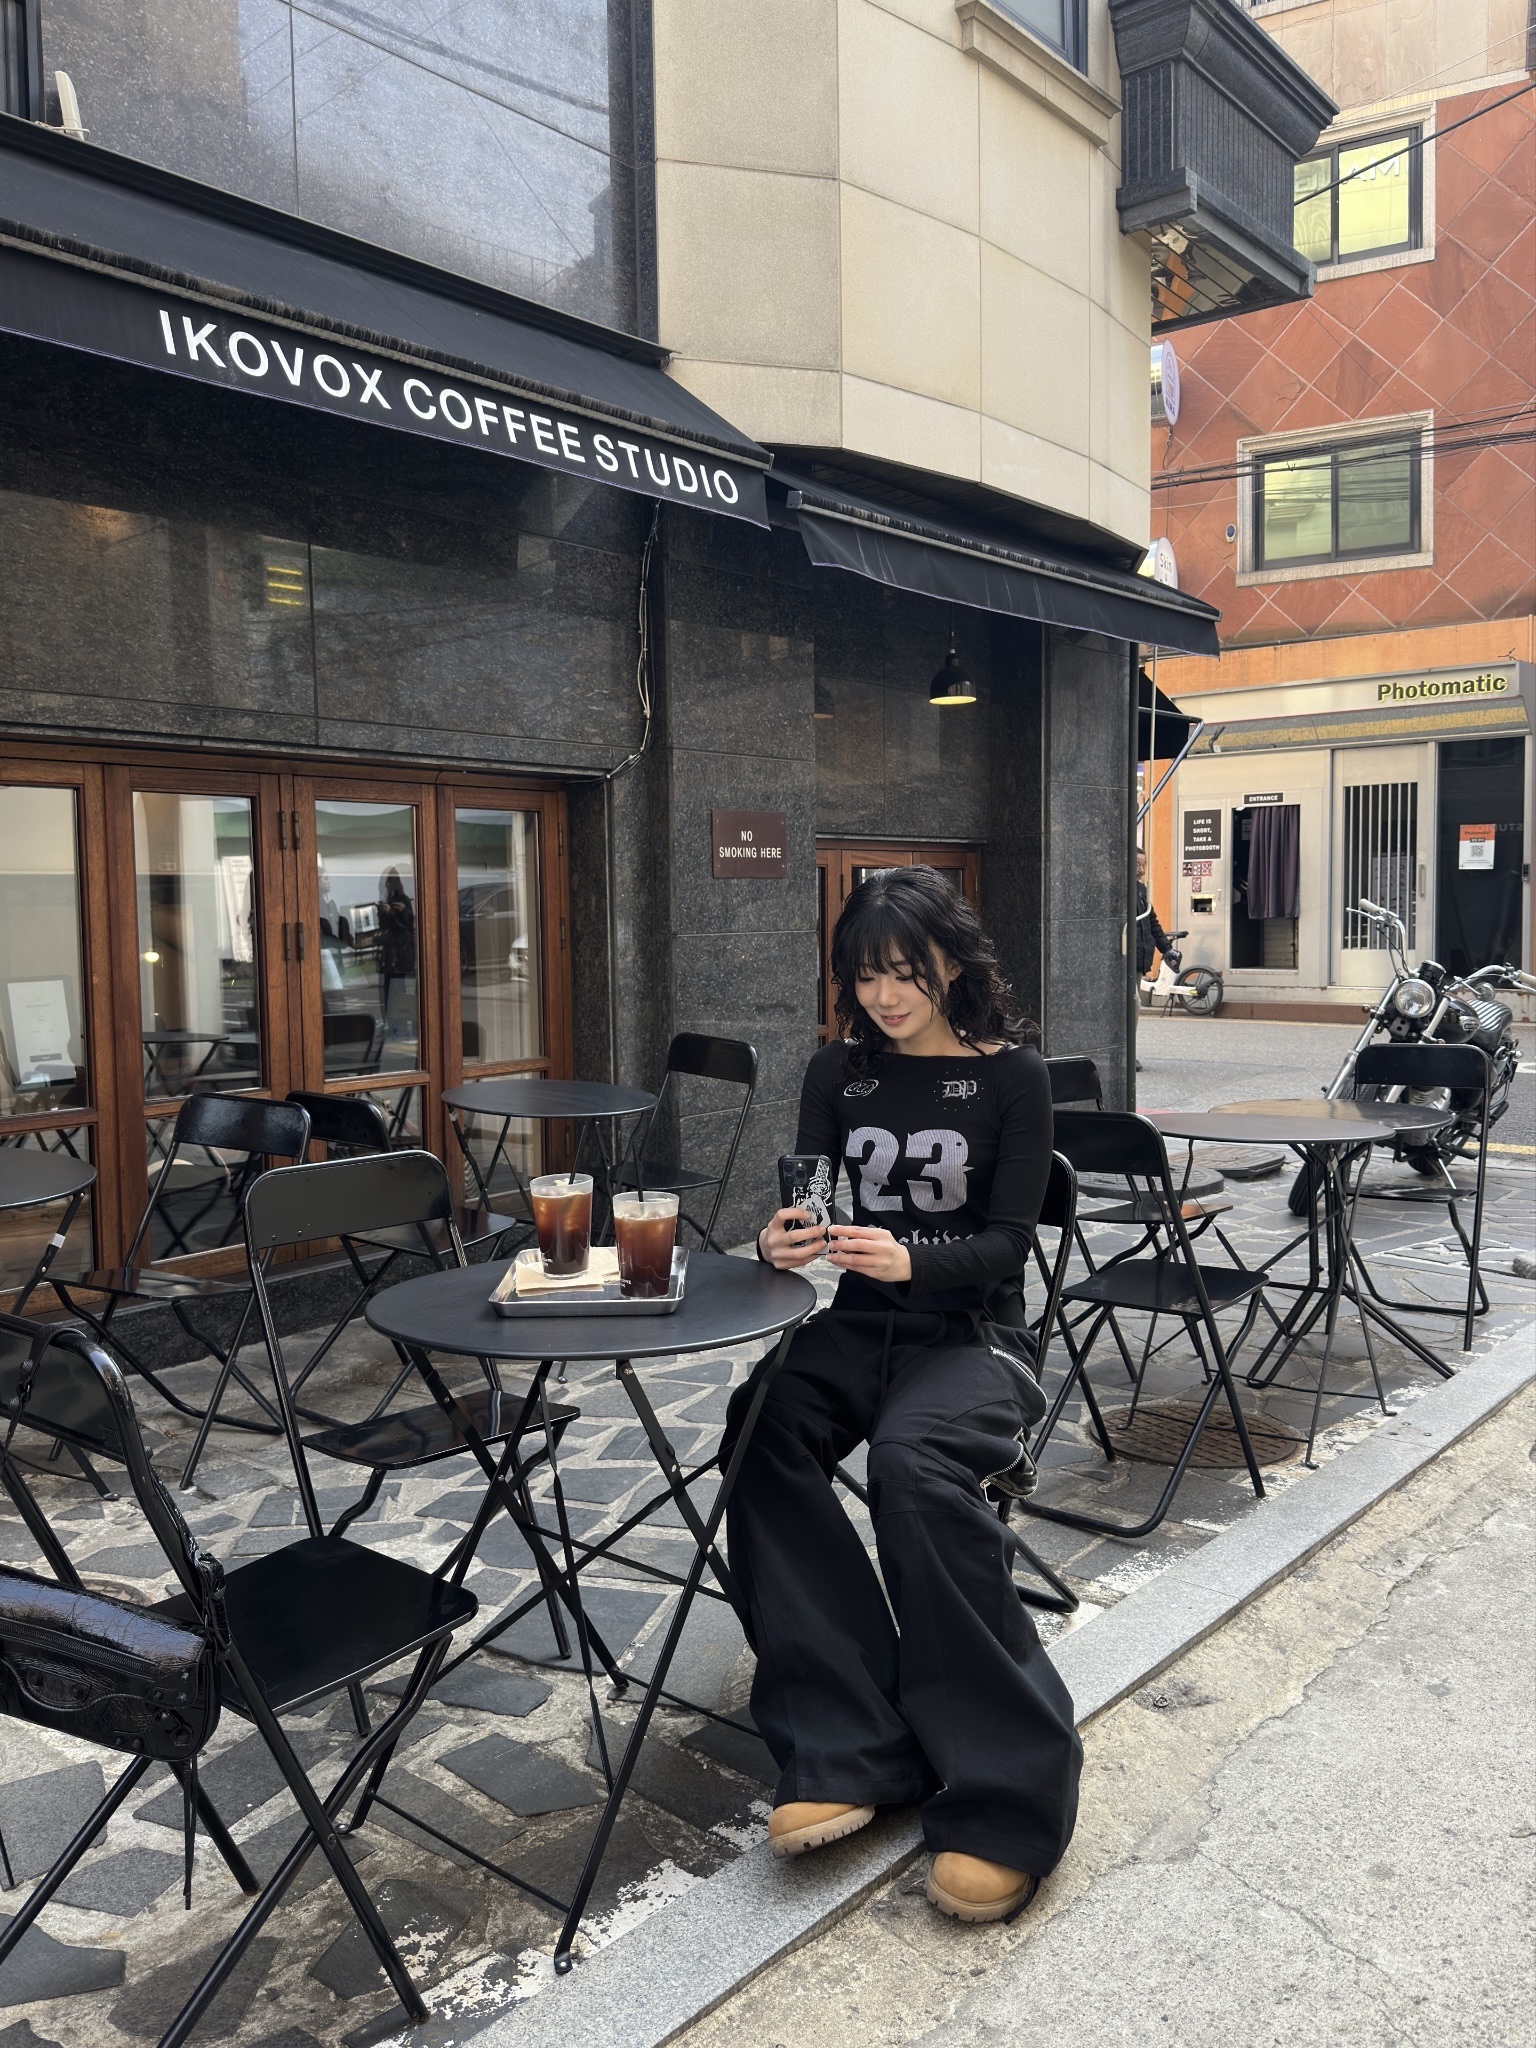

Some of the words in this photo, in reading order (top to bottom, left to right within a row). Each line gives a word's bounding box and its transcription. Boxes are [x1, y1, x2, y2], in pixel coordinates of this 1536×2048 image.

[159, 310, 392, 410] IKOVOX
[403, 378, 586, 463] COFFEE
[593, 434, 739, 504] STUDIO
[1160, 553, 1173, 573] Skin
[1377, 673, 1507, 702] Photomatic
[741, 830, 753, 842] NO
[719, 847, 757, 858] SMOKING
[760, 847, 782, 859] HERE
[845, 1126, 975, 1213] 23
